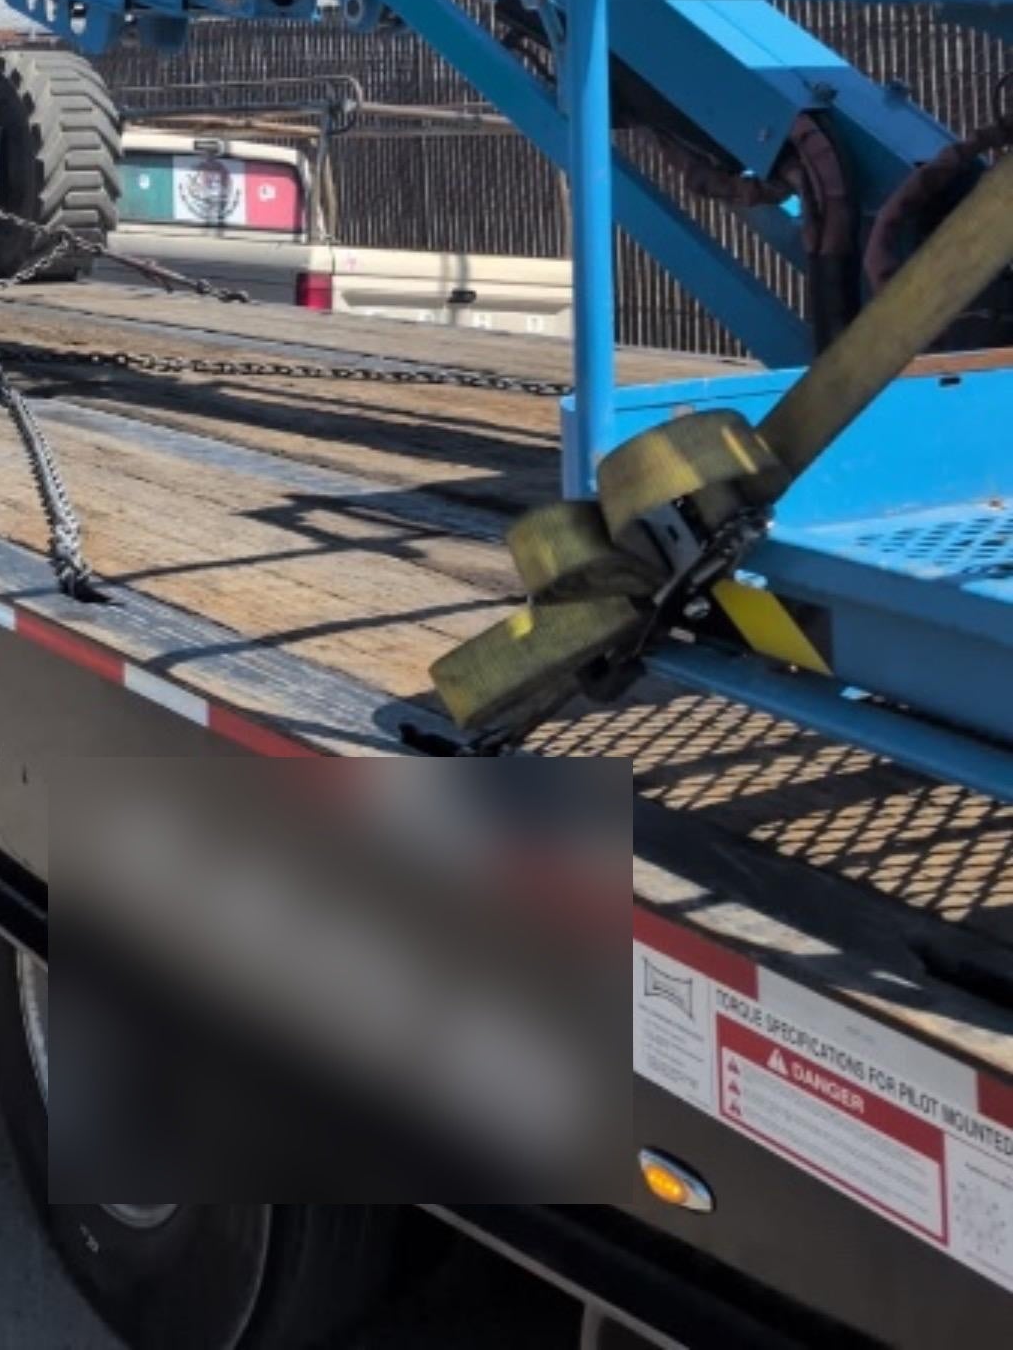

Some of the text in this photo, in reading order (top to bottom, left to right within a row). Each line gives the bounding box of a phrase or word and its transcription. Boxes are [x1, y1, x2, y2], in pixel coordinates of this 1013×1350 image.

[715, 988, 763, 1026] TORQUE
[765, 1012, 865, 1081] SPECIFICATIONS
[868, 1065, 897, 1096] FOR
[898, 1081, 939, 1118] PILOT
[790, 1060, 866, 1115] DANGER
